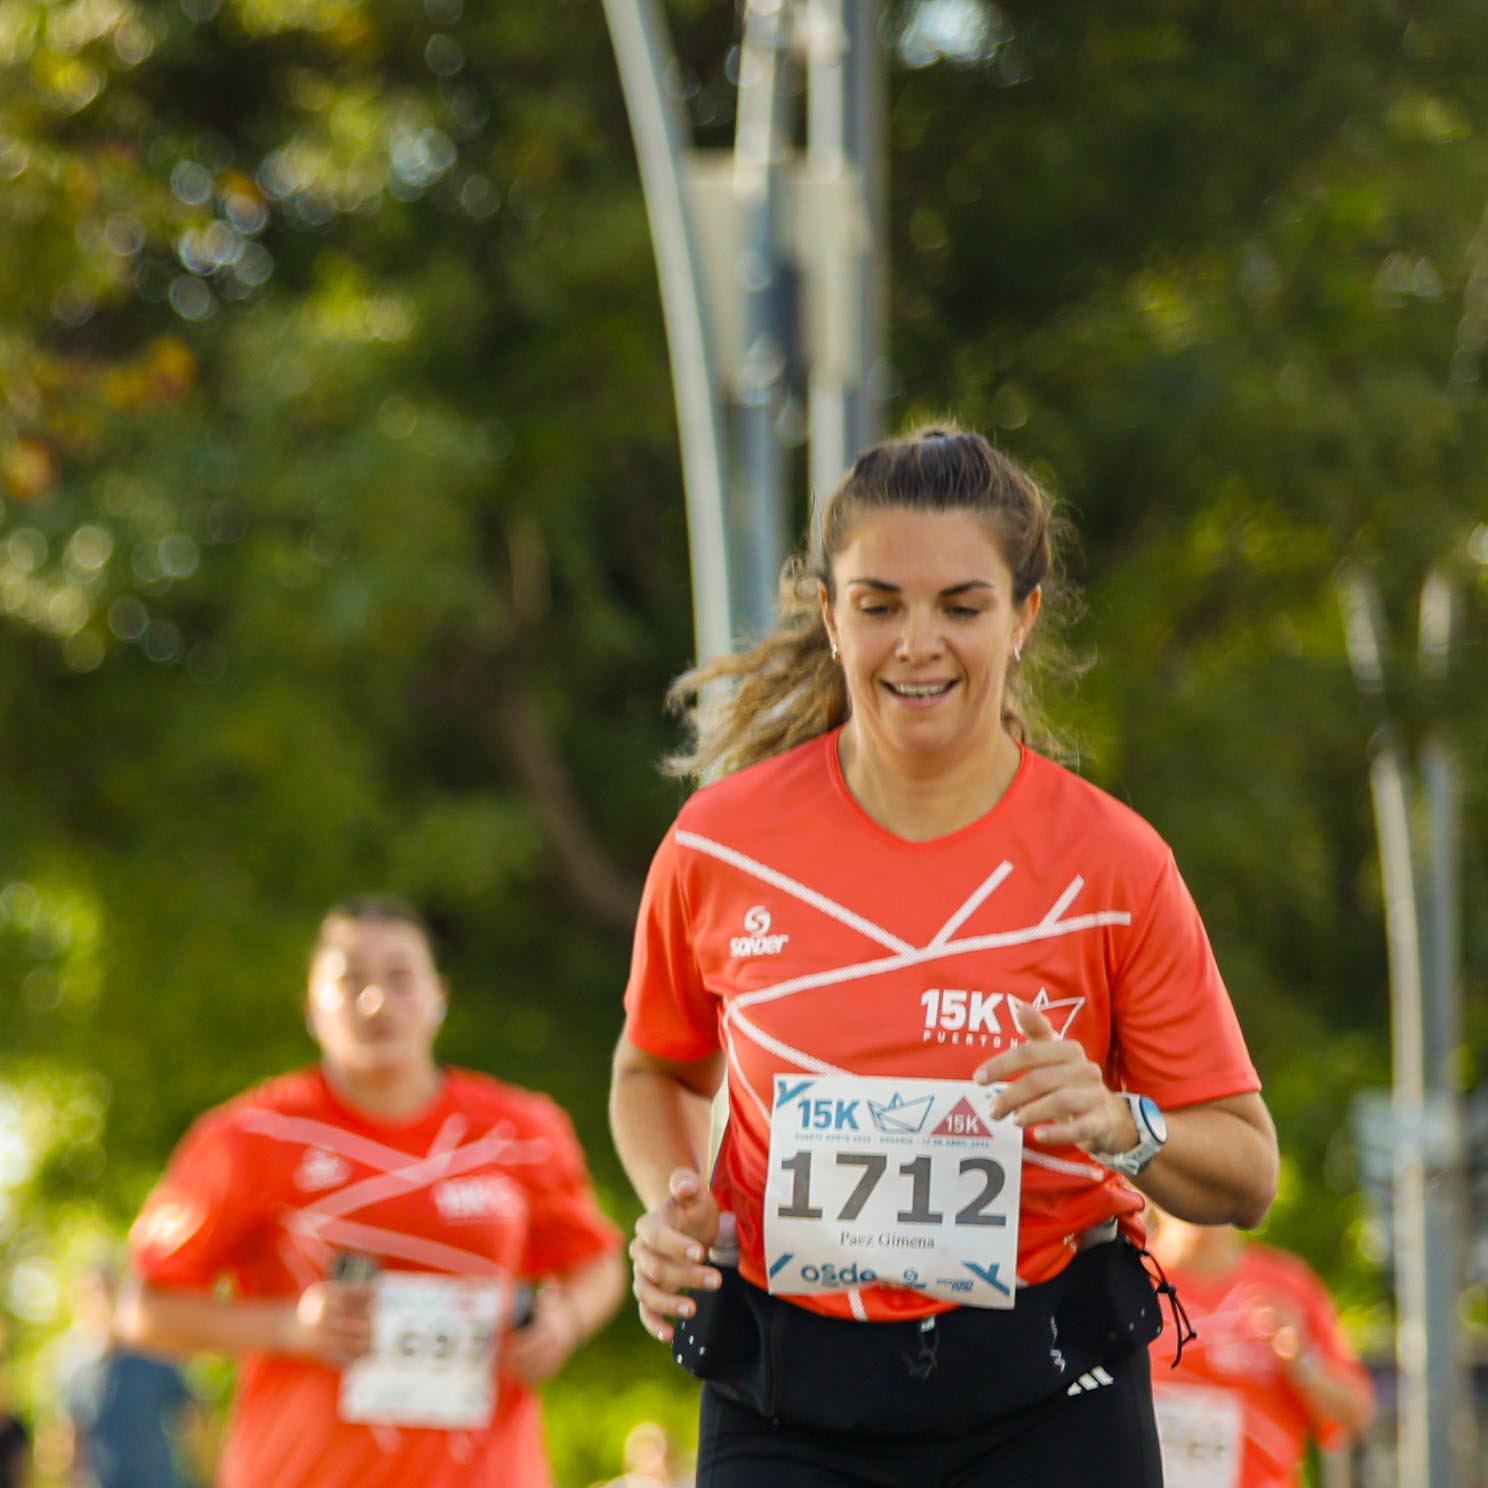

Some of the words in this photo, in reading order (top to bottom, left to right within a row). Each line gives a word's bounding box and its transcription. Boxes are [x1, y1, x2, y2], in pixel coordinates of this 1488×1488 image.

[921, 988, 1004, 1034] 15K
[923, 1030, 1002, 1048] PUERTO
[798, 1099, 861, 1131] 15K
[946, 1113, 980, 1135] 15K
[777, 1149, 1007, 1227] 1712
[878, 1233, 936, 1249] Gimena
